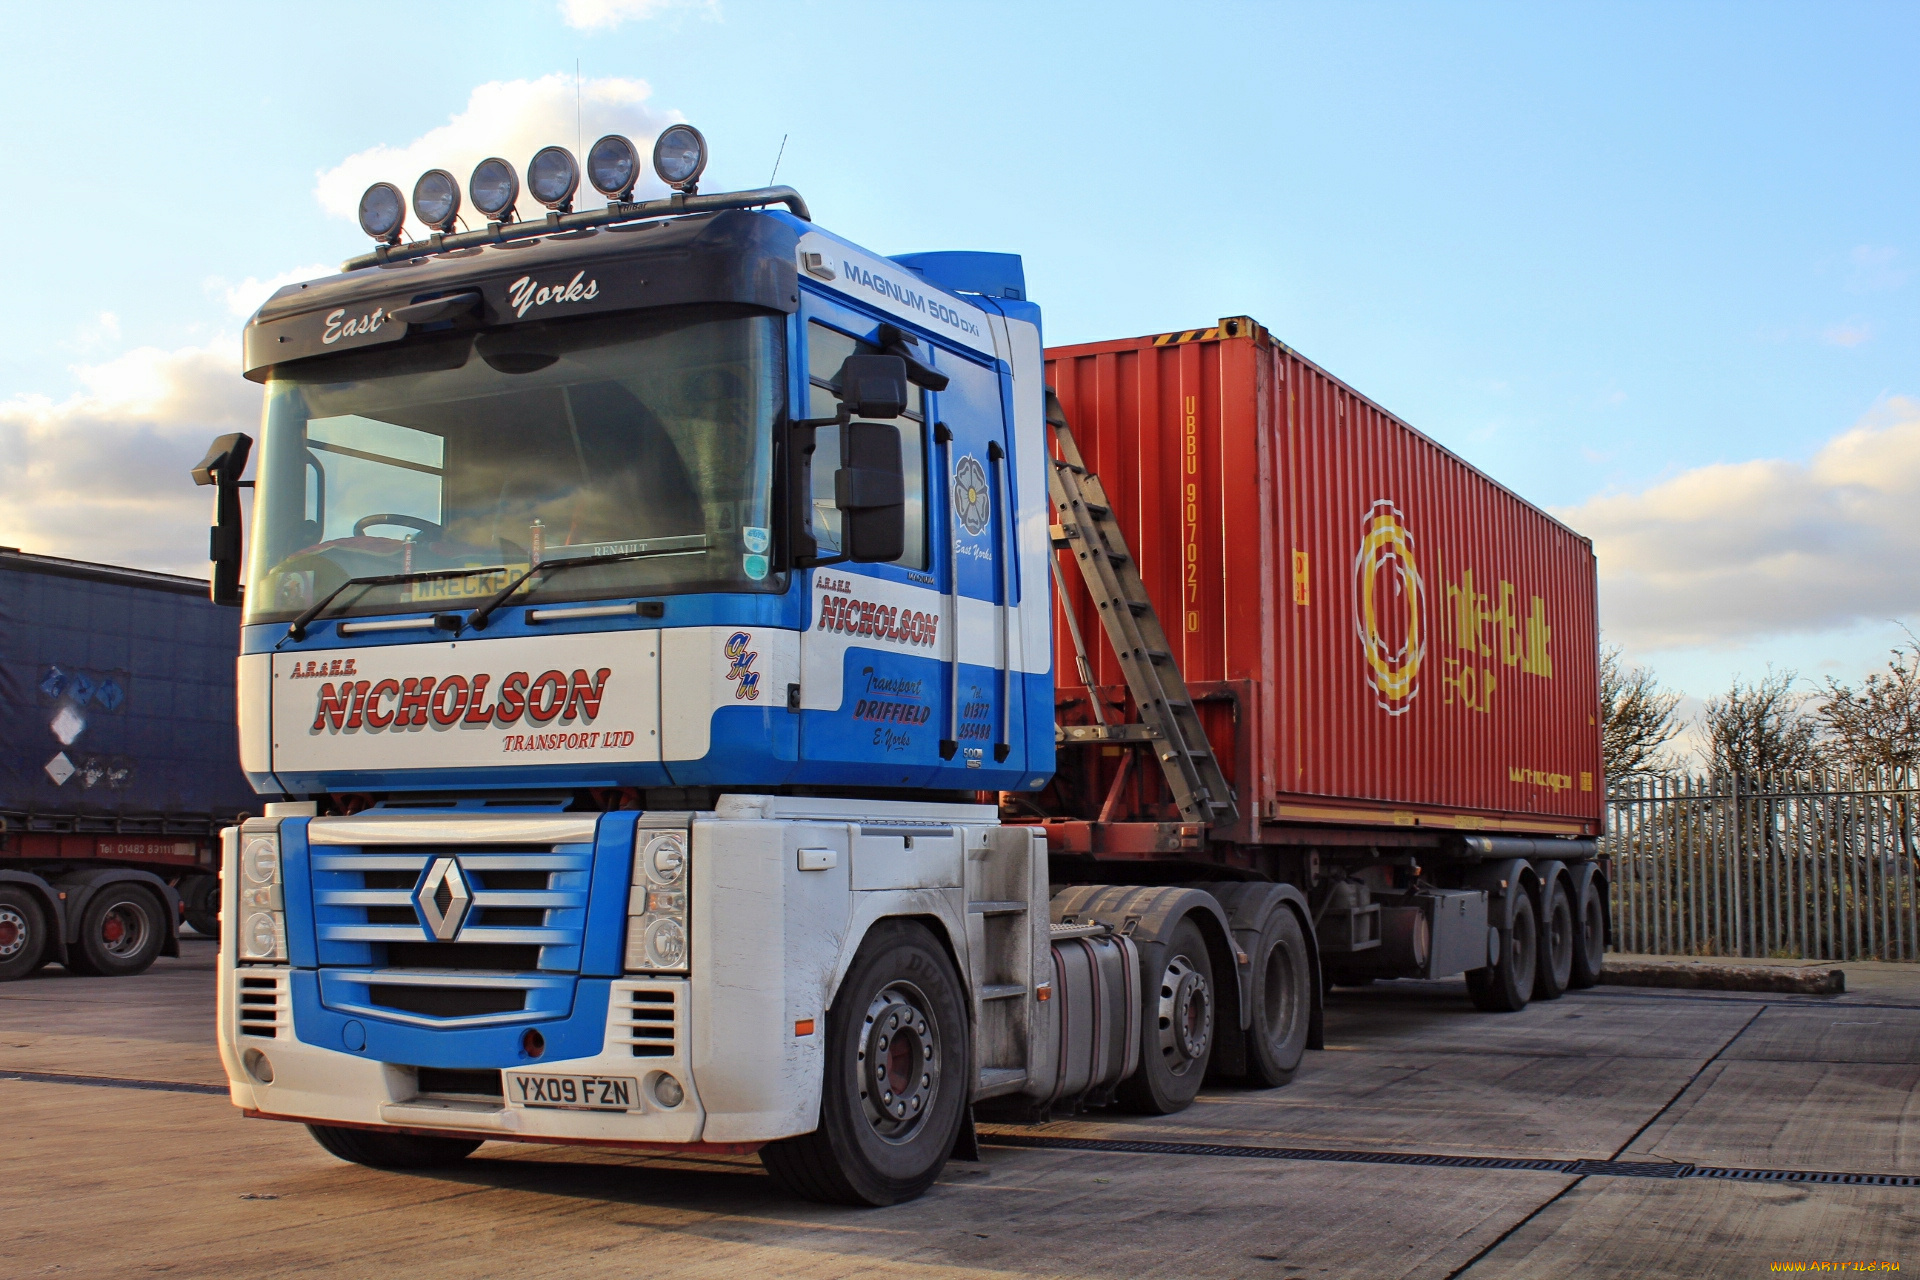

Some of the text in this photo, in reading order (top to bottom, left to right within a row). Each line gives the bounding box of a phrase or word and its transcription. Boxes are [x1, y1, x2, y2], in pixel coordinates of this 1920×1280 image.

[322, 270, 600, 345] East Yorks
[843, 260, 926, 313] MAGNUM
[927, 299, 960, 328] 500
[1186, 395, 1197, 475] UBBU
[955, 540, 992, 561] East Yorks
[1187, 483, 1198, 603] 907027
[819, 594, 939, 647] NICHOLSON
[862, 666, 922, 696] Transport
[311, 668, 612, 733] NICHOLSON
[853, 699, 931, 726] DRIFFIELD
[963, 702, 990, 720] 01377
[503, 730, 635, 752] TRANSPORT LTD
[100, 844, 114, 854] Tel:
[117, 844, 144, 854] 01482
[516, 1076, 630, 1105] YX09 FZN
